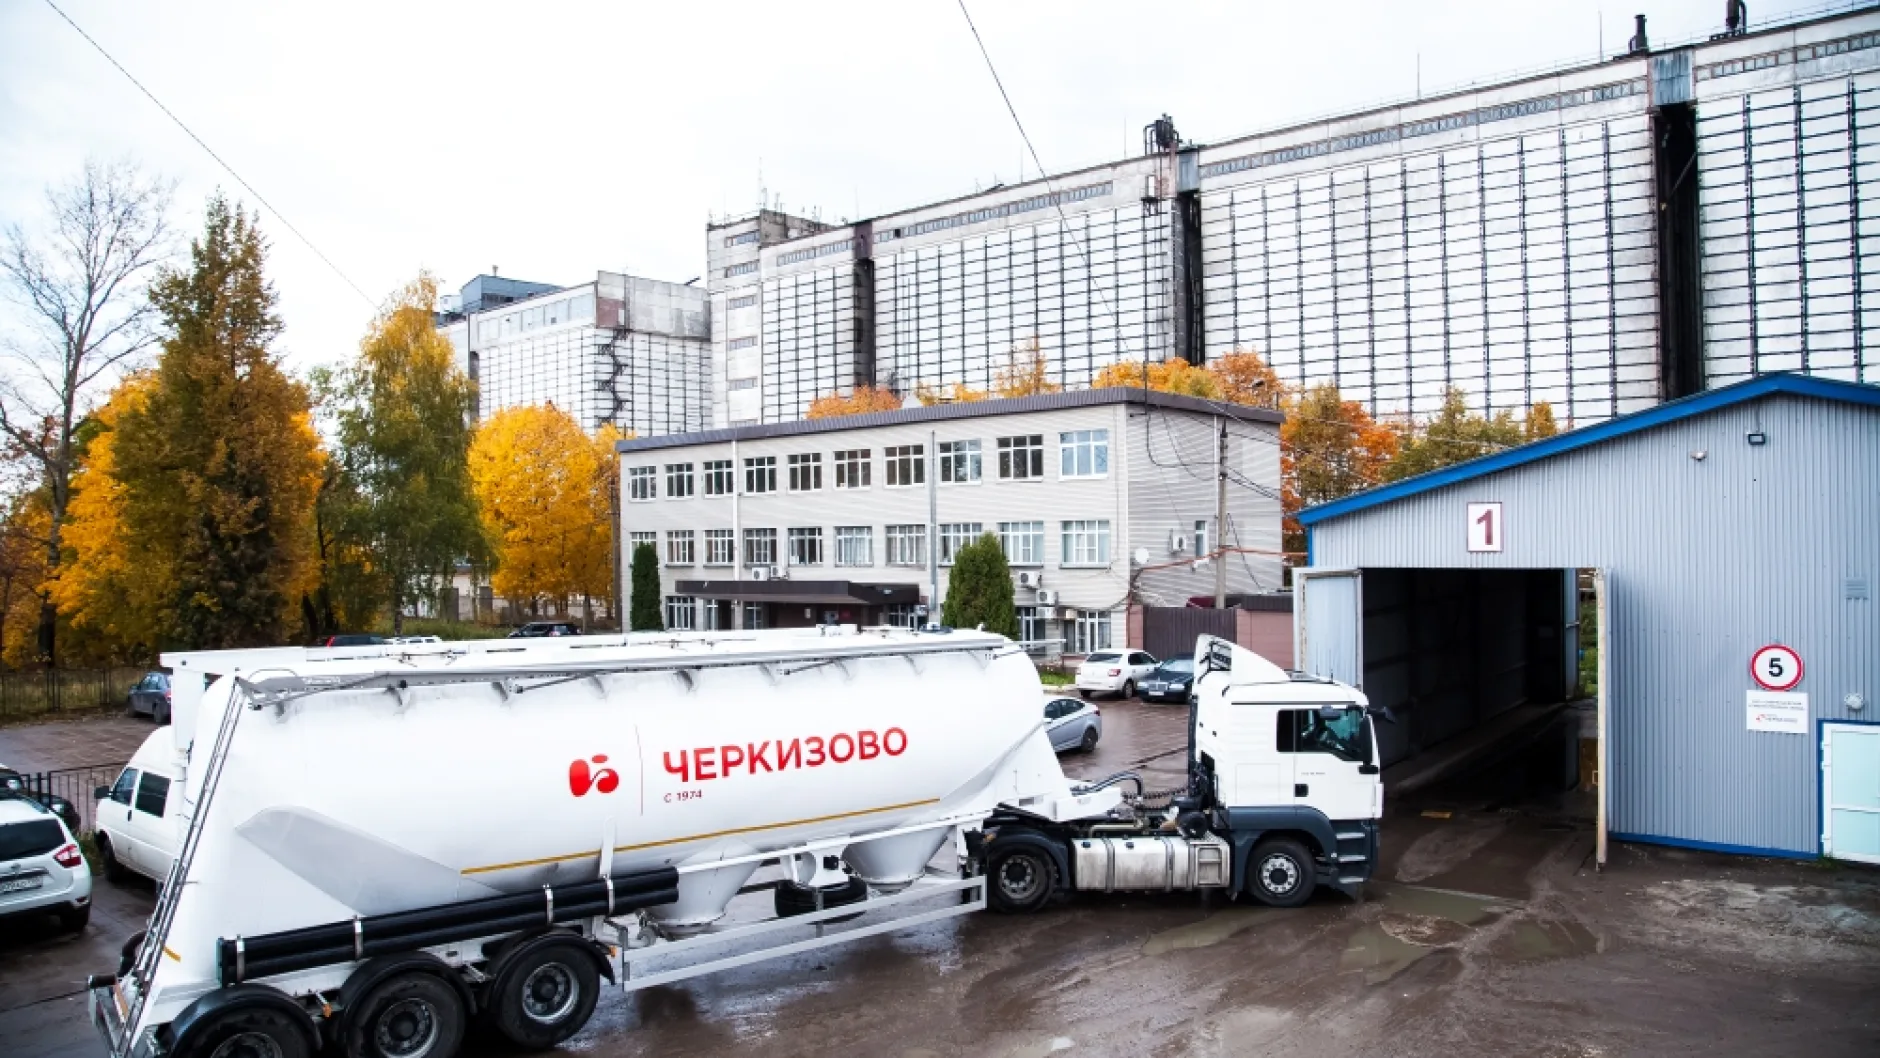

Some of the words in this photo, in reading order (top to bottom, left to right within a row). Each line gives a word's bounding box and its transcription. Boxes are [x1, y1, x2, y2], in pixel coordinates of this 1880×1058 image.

[1476, 509, 1493, 545] 1
[1768, 657, 1784, 678] 5
[662, 726, 908, 783] ЧЕРКИЗОВО
[676, 789, 702, 802] 1974
